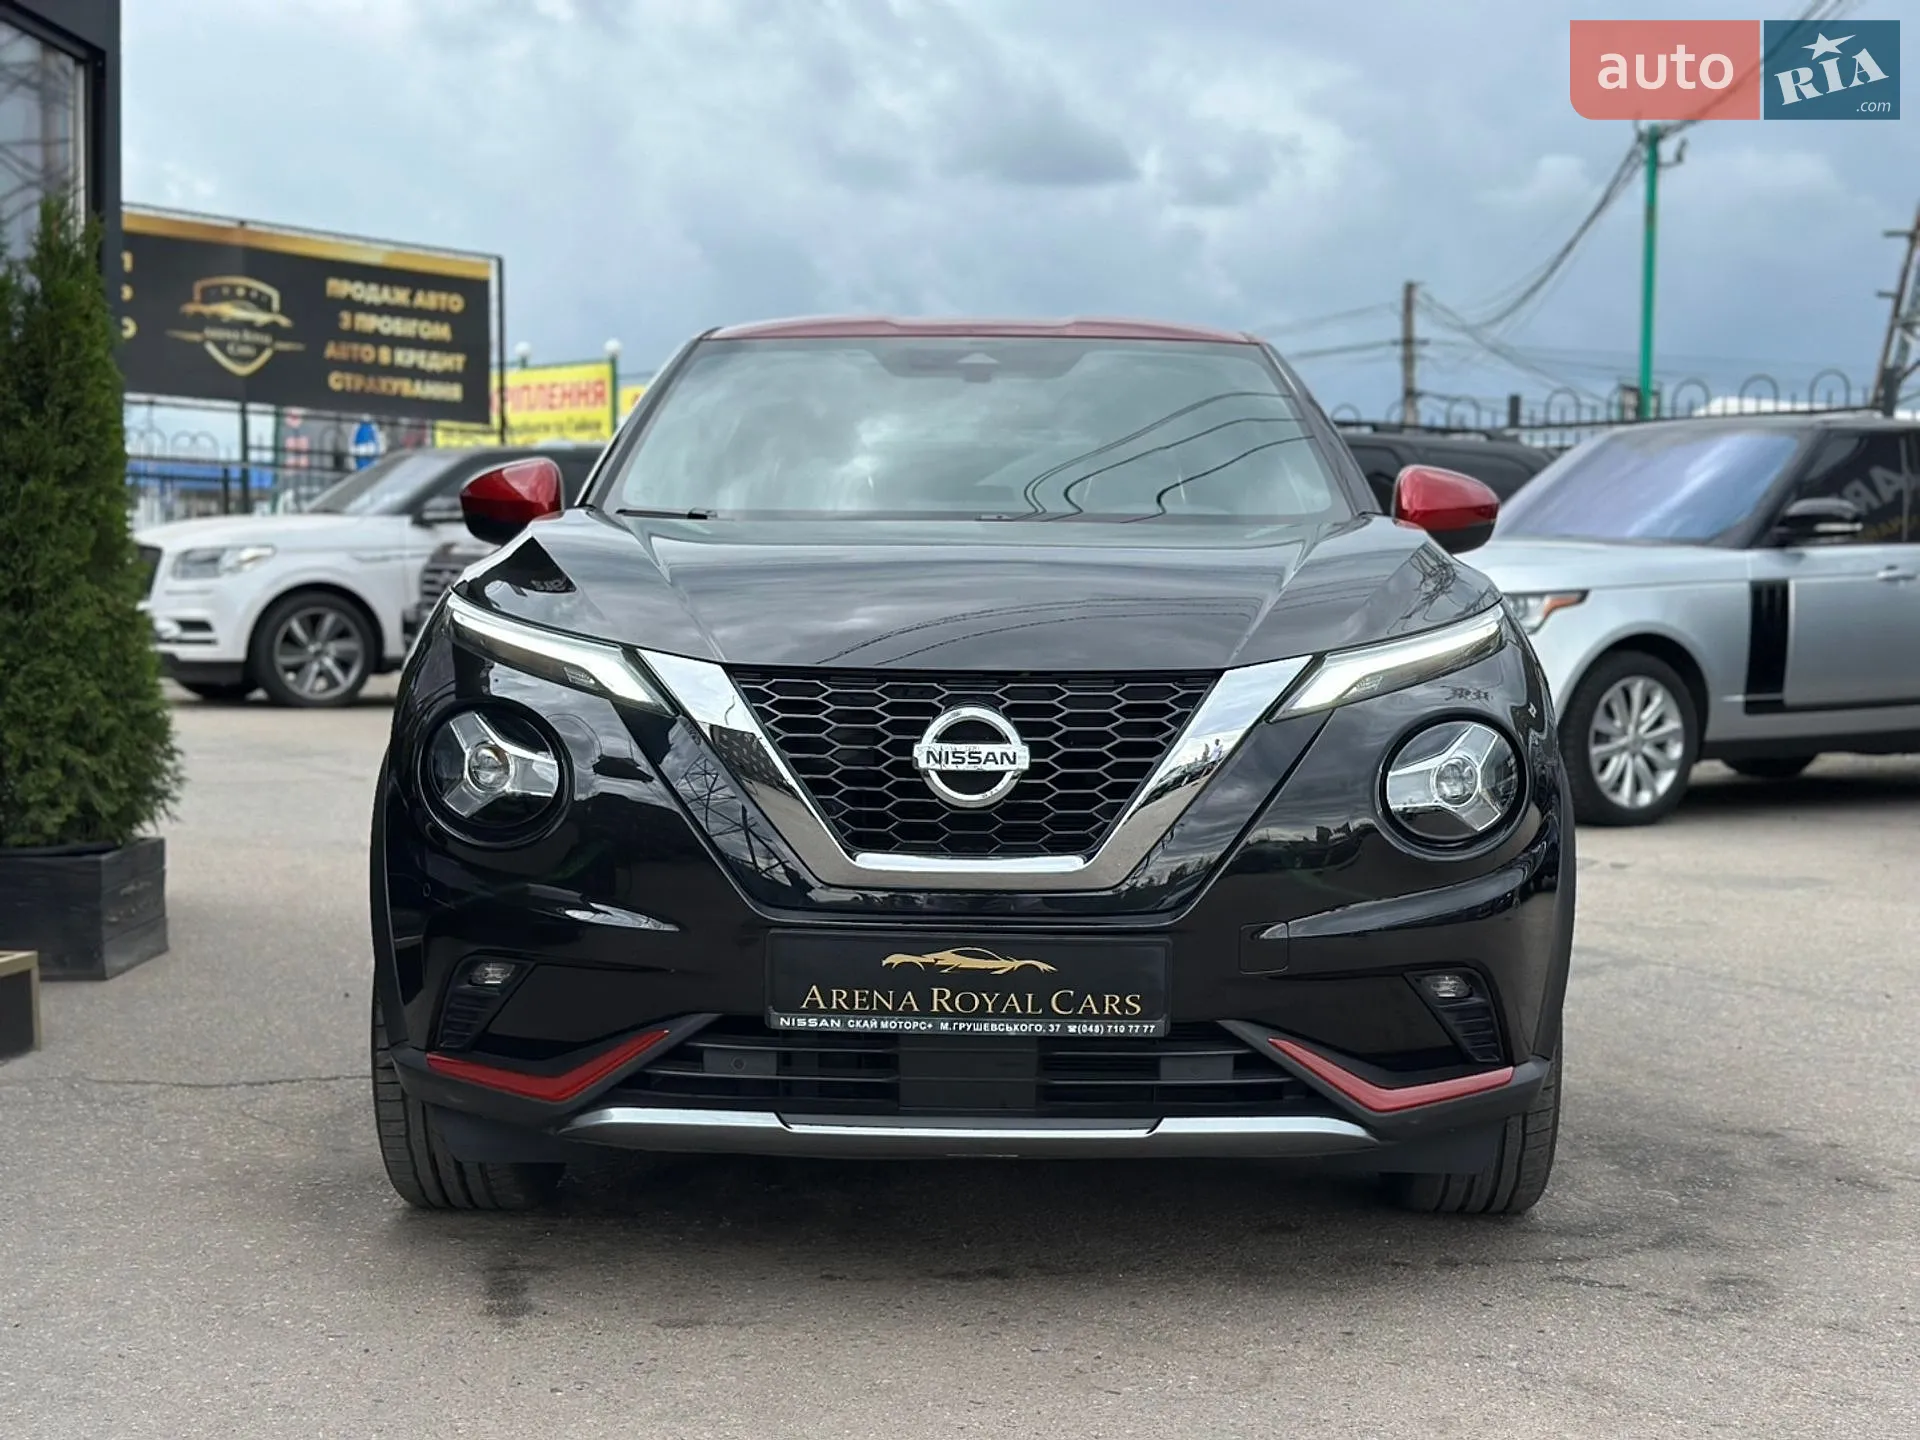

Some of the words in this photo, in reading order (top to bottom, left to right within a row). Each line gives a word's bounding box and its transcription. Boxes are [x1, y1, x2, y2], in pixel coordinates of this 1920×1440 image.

[413, 289, 465, 314] АВТО
[324, 340, 376, 364] АВТО
[926, 750, 1017, 765] NISSAN
[800, 984, 920, 1012] ARENA
[930, 987, 1043, 1015] ROYAL
[1050, 990, 1142, 1016] CARS
[779, 1017, 841, 1028] NISSAN
[847, 1018, 878, 1029] СКАЙ
[1048, 1023, 1061, 1033] 37
[1107, 1025, 1125, 1034] 710
